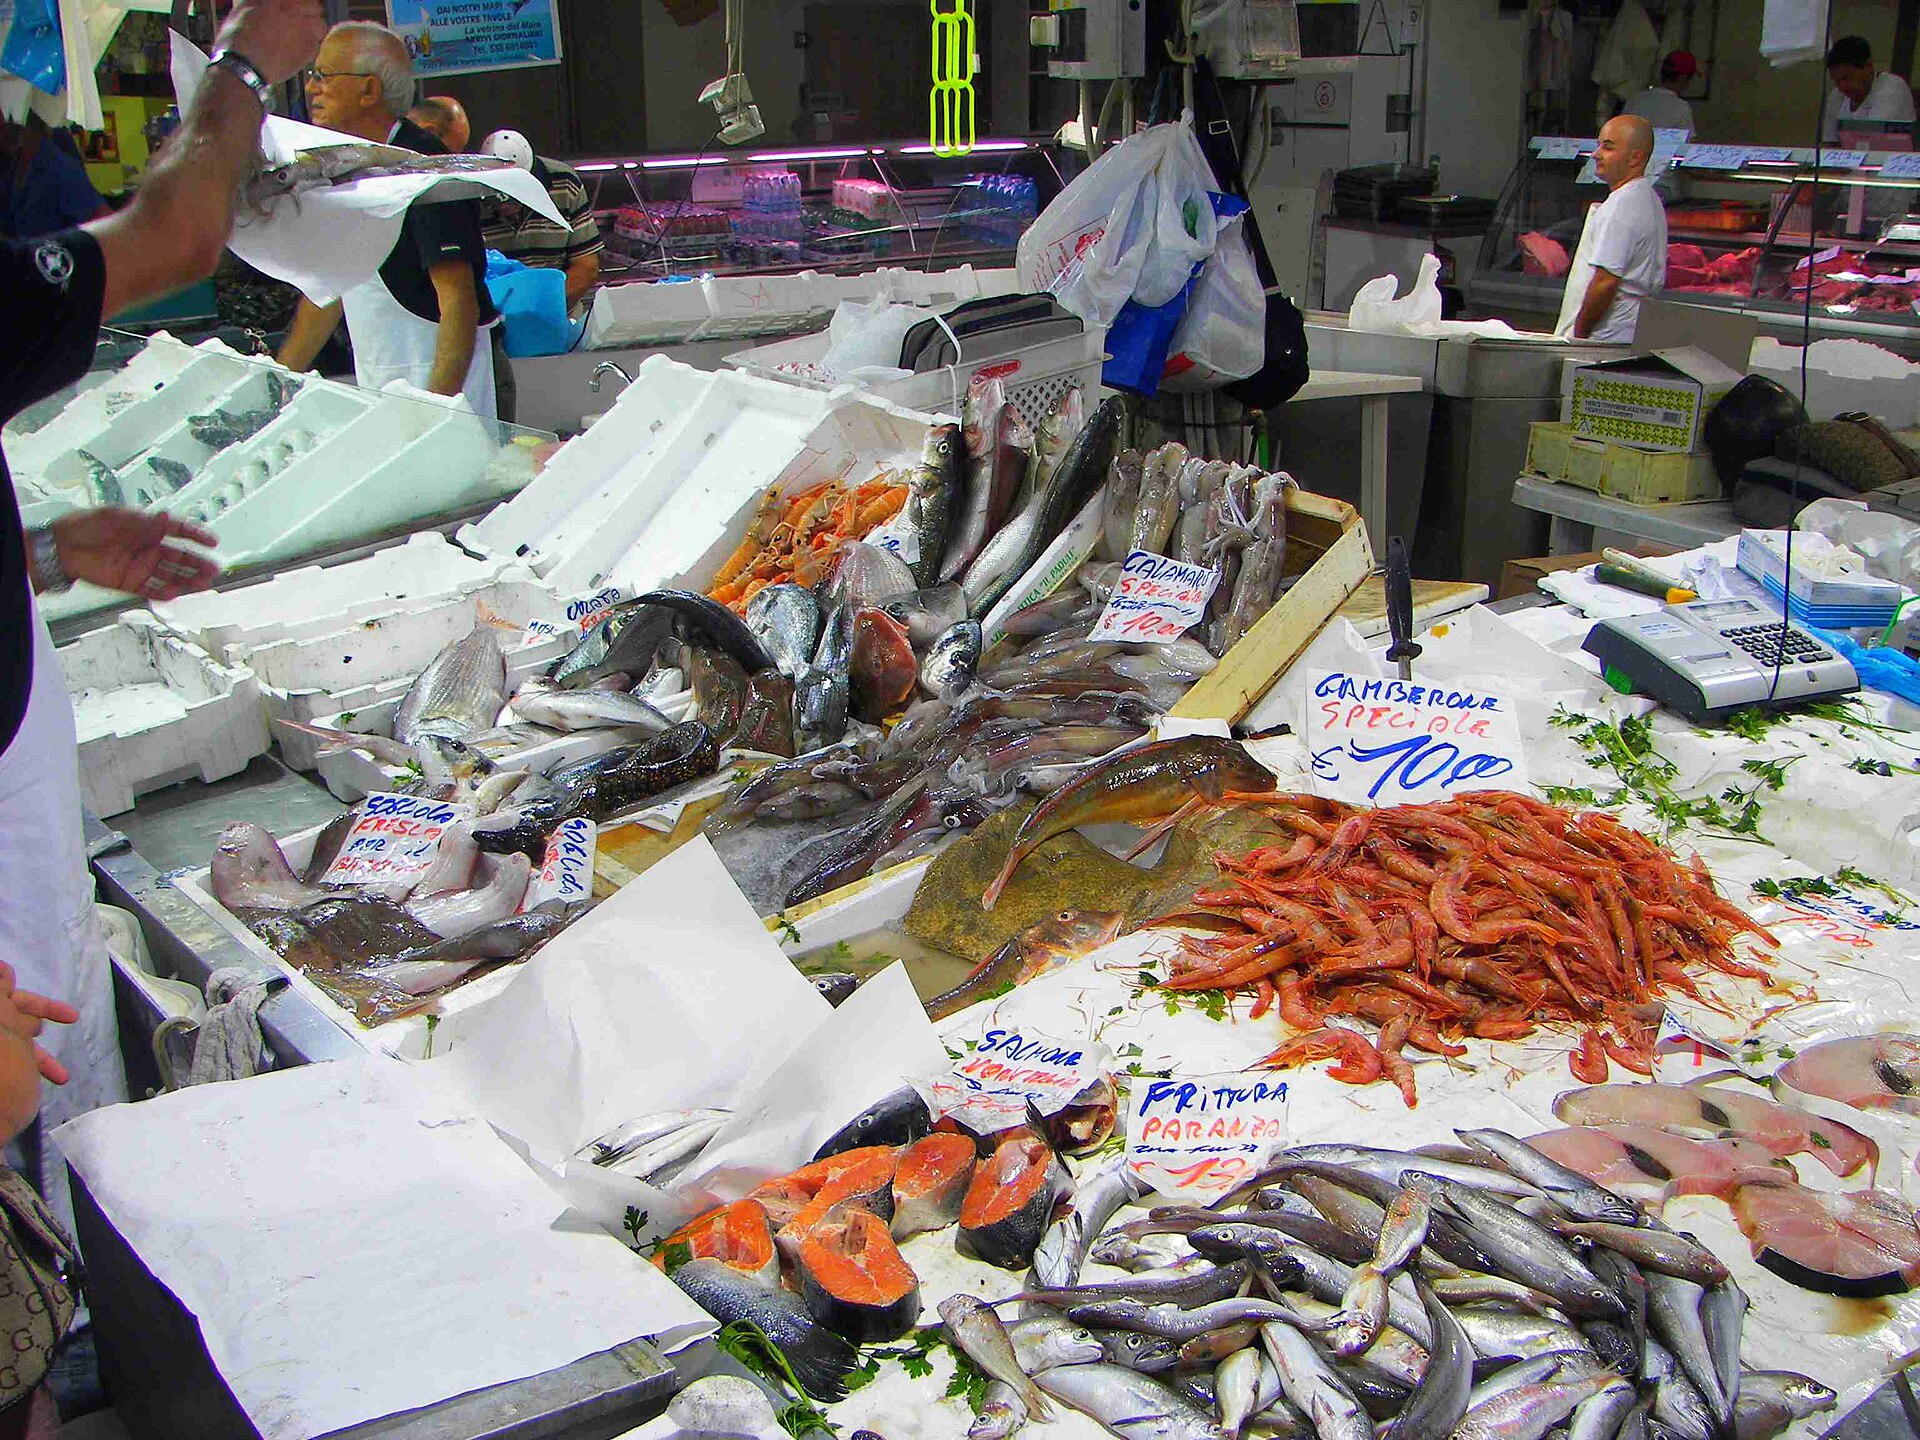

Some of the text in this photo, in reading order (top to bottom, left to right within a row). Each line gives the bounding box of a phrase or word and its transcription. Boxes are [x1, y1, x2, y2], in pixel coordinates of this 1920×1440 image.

[452, 4, 481, 13] NOSTRI
[430, 18, 449, 27] ALLE
[450, 15, 481, 24] VOSTRE
[1314, 672, 1504, 713] GAMBERONE
[1311, 746, 1344, 782] €
